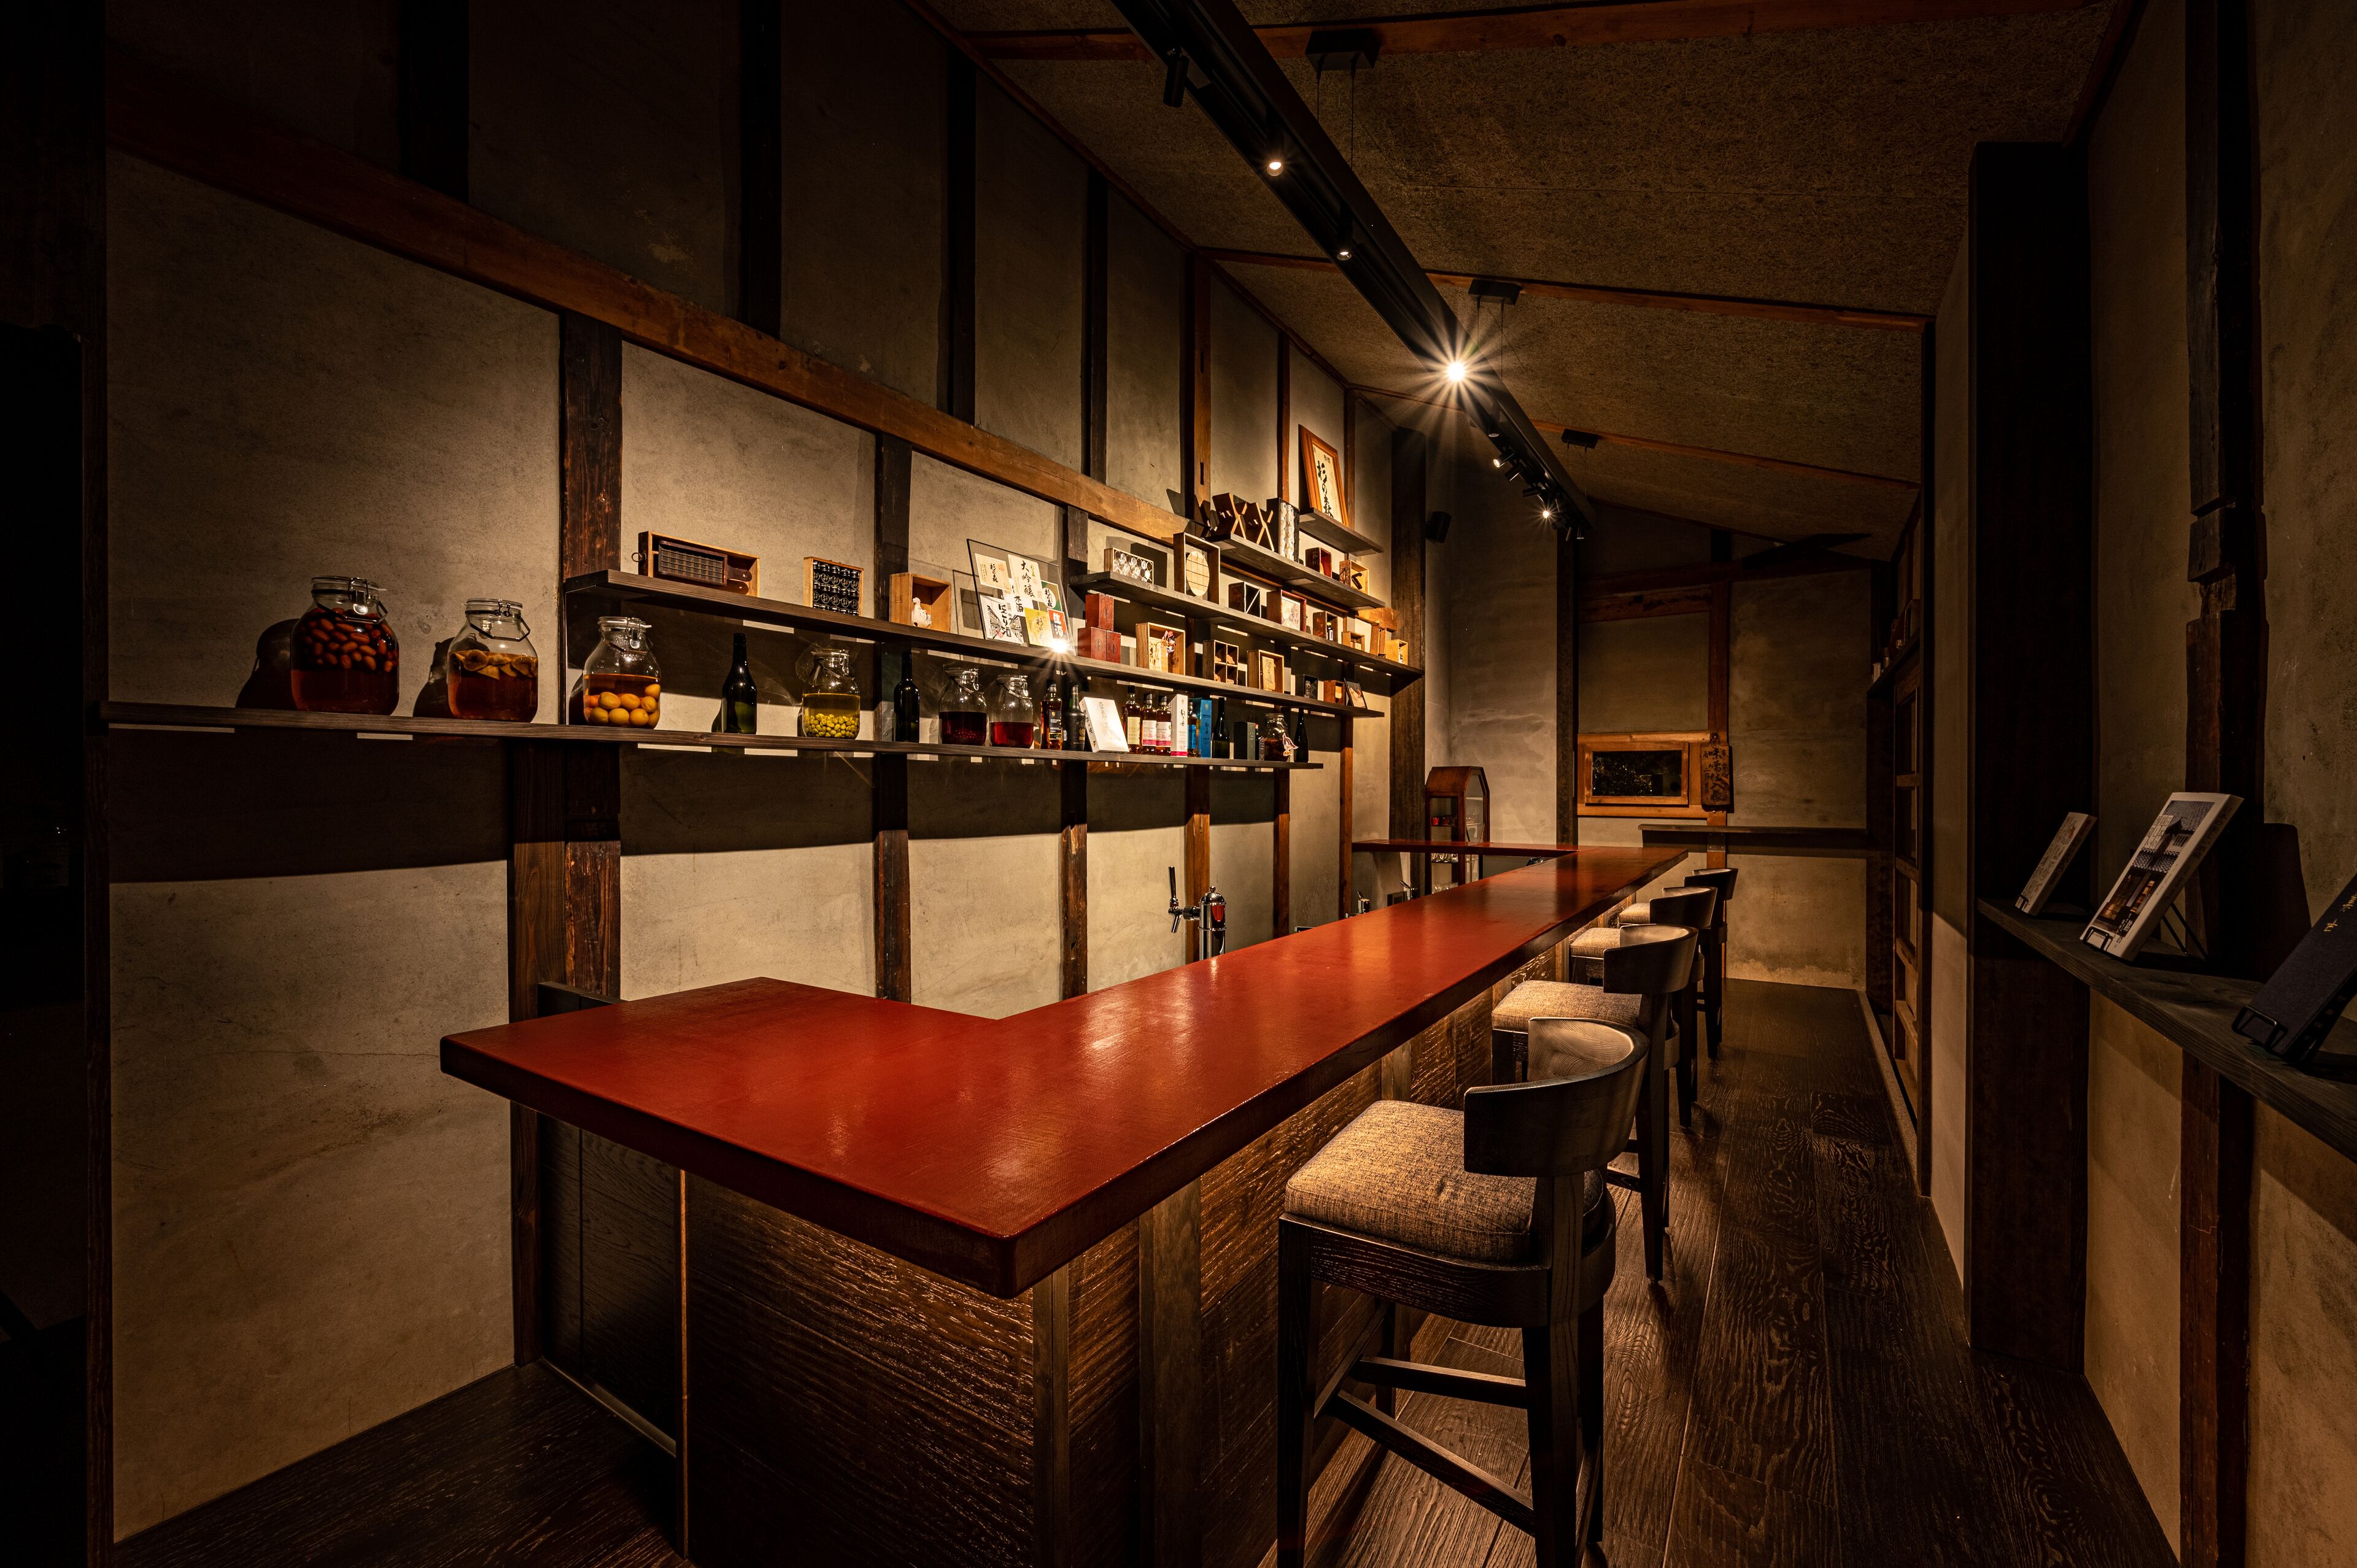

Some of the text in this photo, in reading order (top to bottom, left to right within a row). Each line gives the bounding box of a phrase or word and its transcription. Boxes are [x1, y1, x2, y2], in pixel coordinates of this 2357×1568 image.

[990, 563, 999, 583] 杉の森
[1021, 560, 1035, 598] 大吟醸
